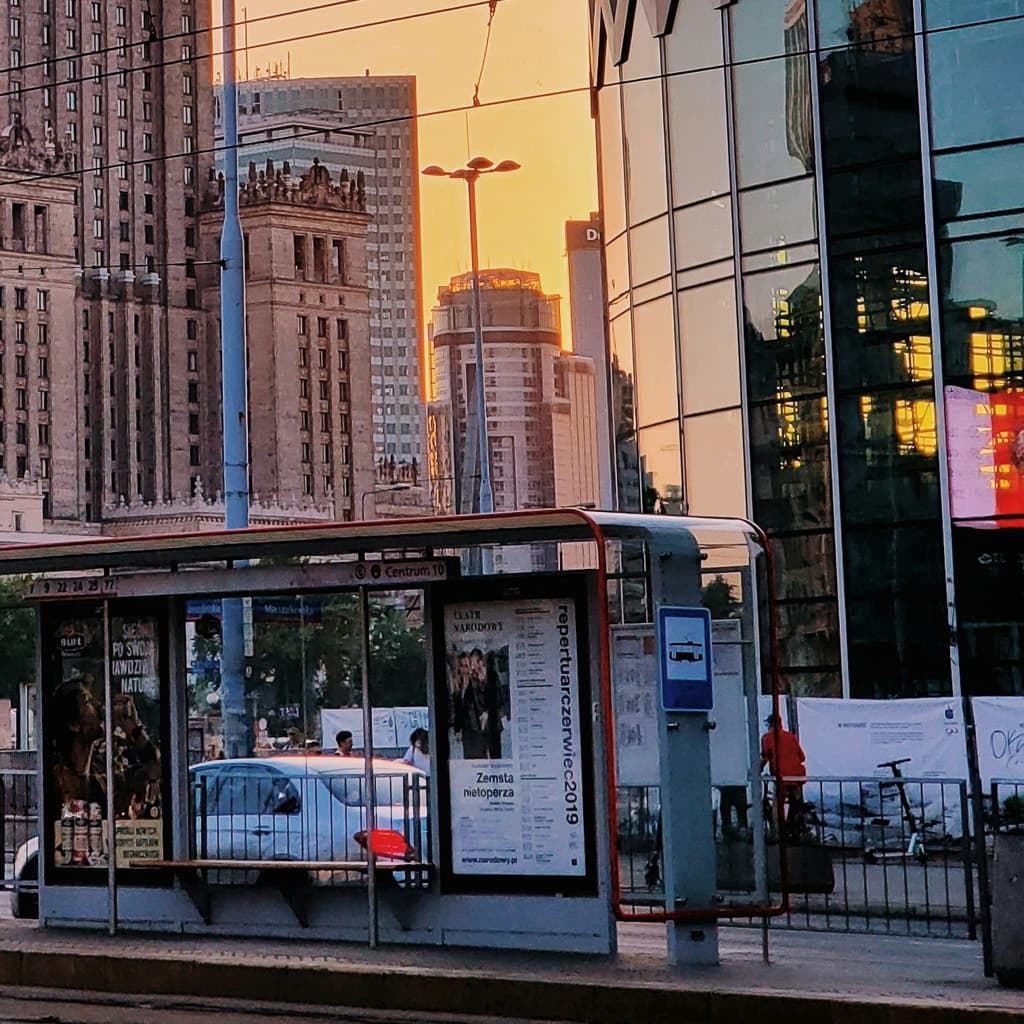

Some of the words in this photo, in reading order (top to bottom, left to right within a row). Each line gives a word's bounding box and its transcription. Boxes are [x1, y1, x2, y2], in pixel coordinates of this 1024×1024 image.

[385, 564, 431, 578] Centrum
[433, 563, 445, 576] 10
[44, 581, 50, 593] 9
[57, 581, 67, 593] 22
[73, 580, 83, 592] 24
[476, 772, 514, 784] Zemsta
[463, 786, 514, 800] nietoperza
